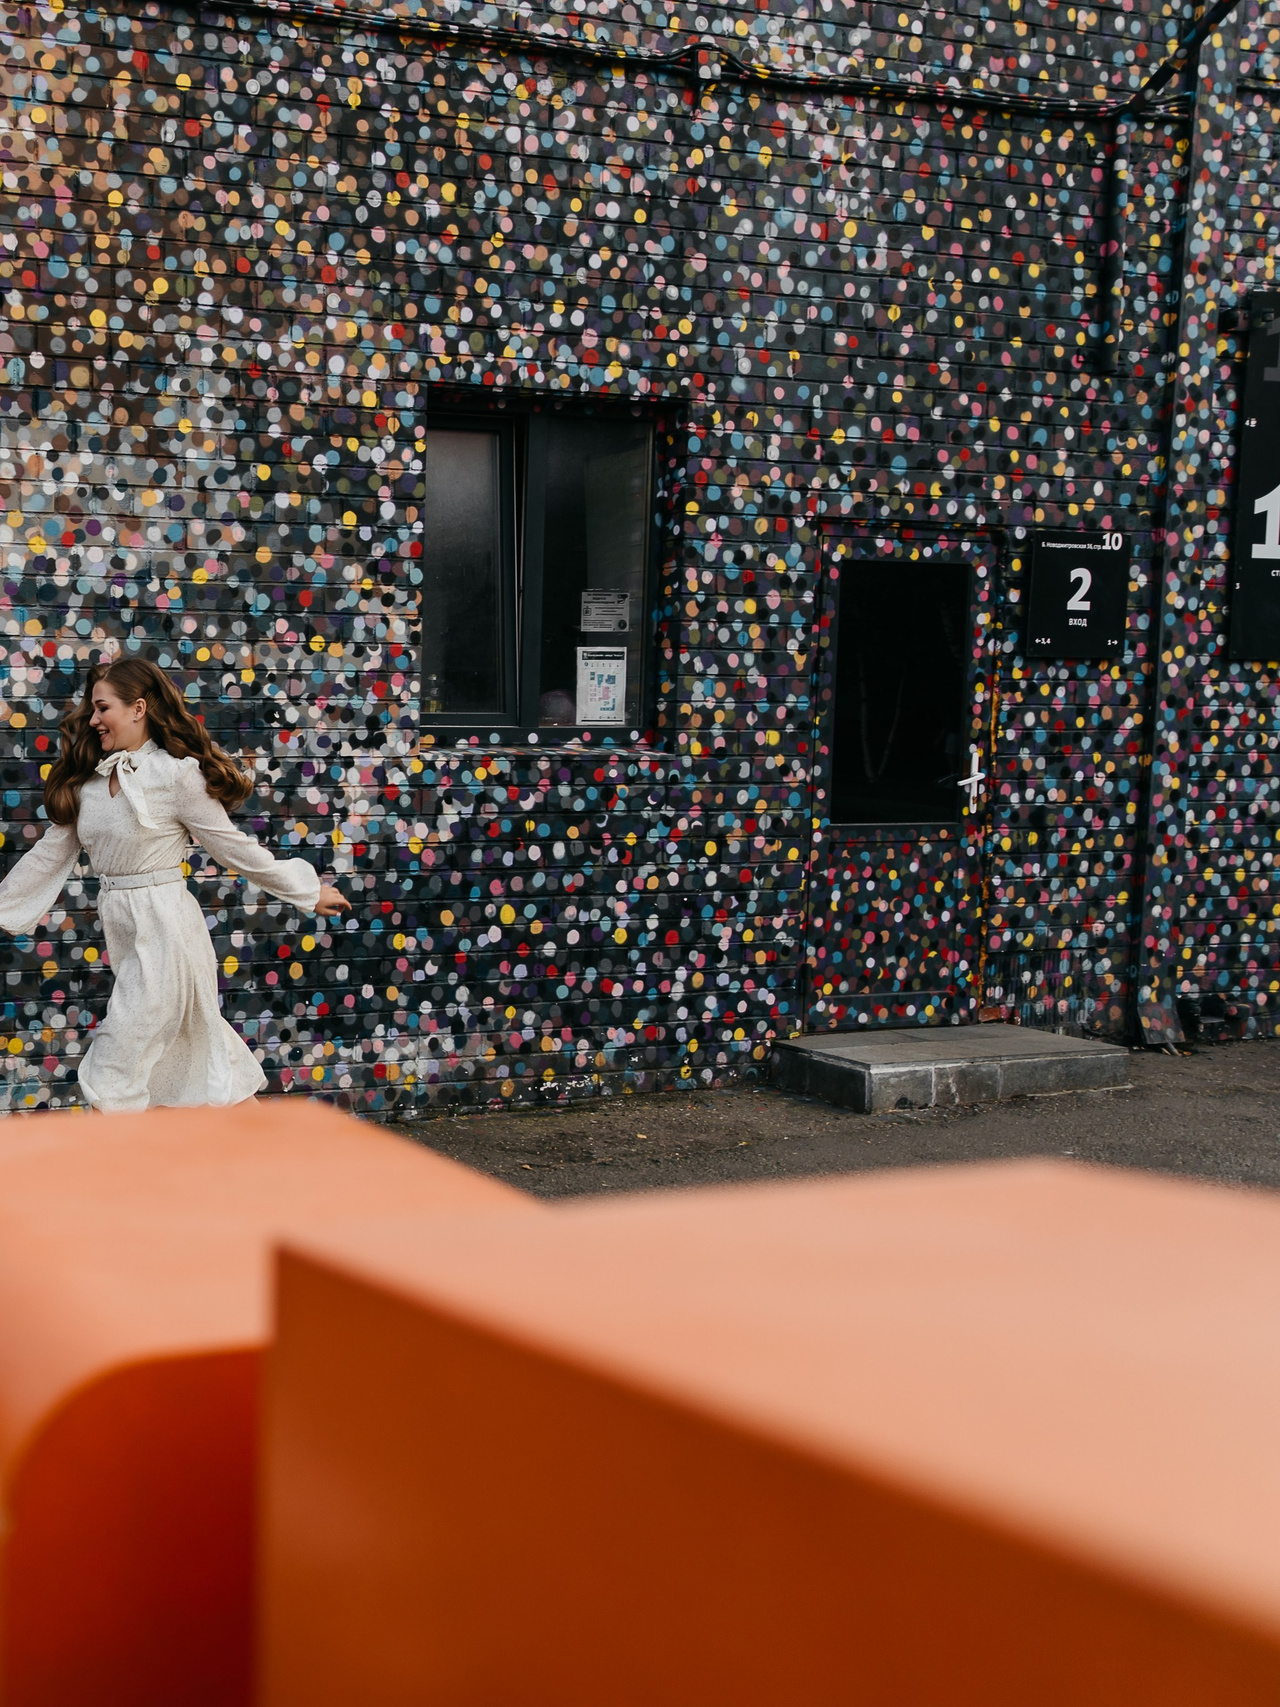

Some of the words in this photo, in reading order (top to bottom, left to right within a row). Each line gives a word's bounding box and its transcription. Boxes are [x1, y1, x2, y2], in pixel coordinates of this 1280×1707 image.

[1102, 532, 1123, 551] 10
[1066, 567, 1092, 611] 2
[1069, 617, 1087, 628] ВХОД
